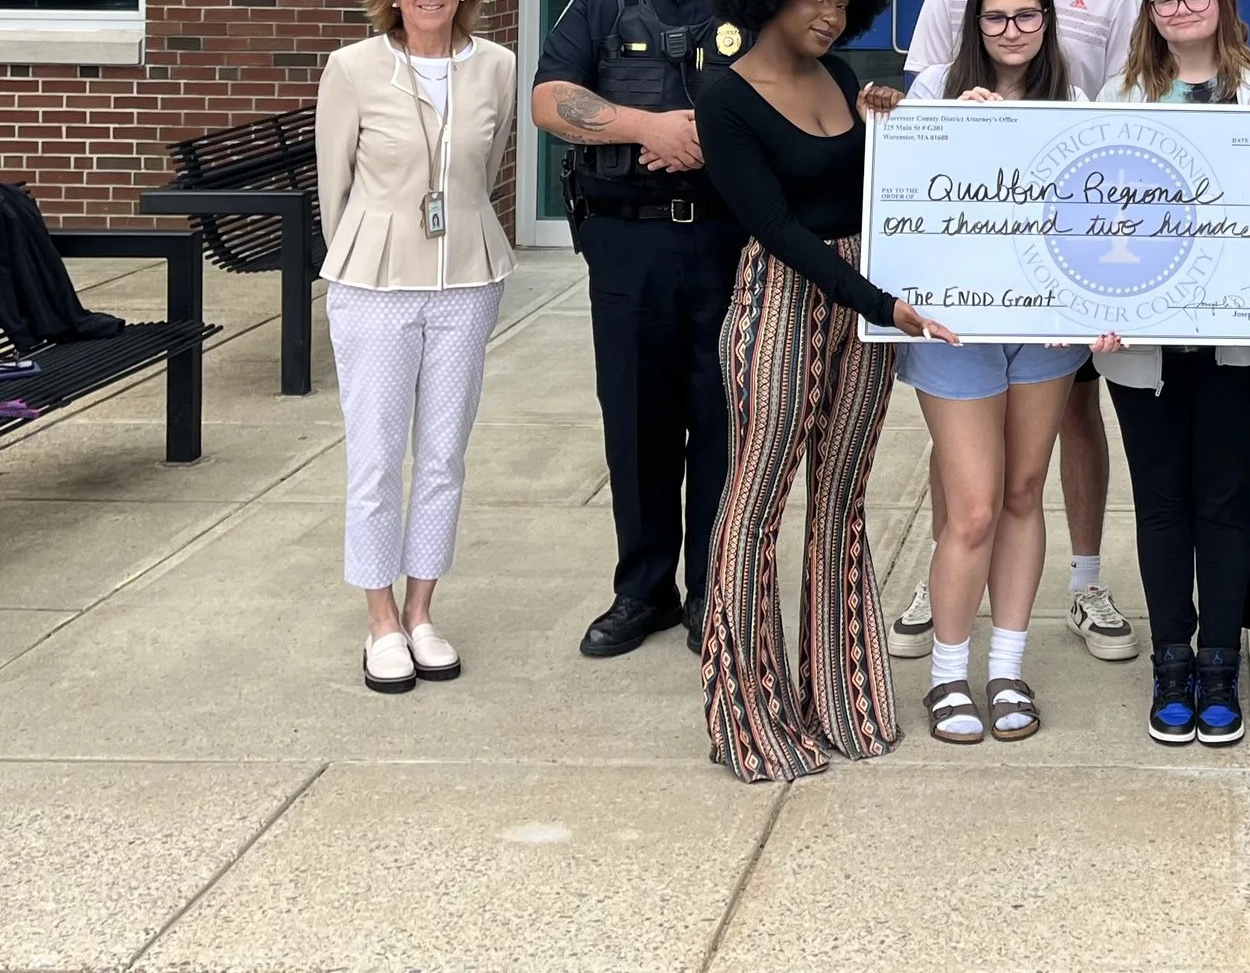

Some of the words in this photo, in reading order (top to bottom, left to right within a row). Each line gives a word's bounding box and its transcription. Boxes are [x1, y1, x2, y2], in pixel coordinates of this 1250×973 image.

[1028, 123, 1111, 194] DISTRICT
[928, 167, 1073, 205] Quabbin
[1084, 171, 1224, 211] Regional
[883, 216, 925, 236] one
[942, 211, 1073, 235] thousand
[1086, 214, 1144, 236] two
[902, 286, 933, 305] The
[943, 286, 994, 307] ENDD
[1002, 289, 1056, 307] Grant
[1022, 243, 1129, 323] WORCESTER
[1136, 248, 1214, 321] COUNTY
